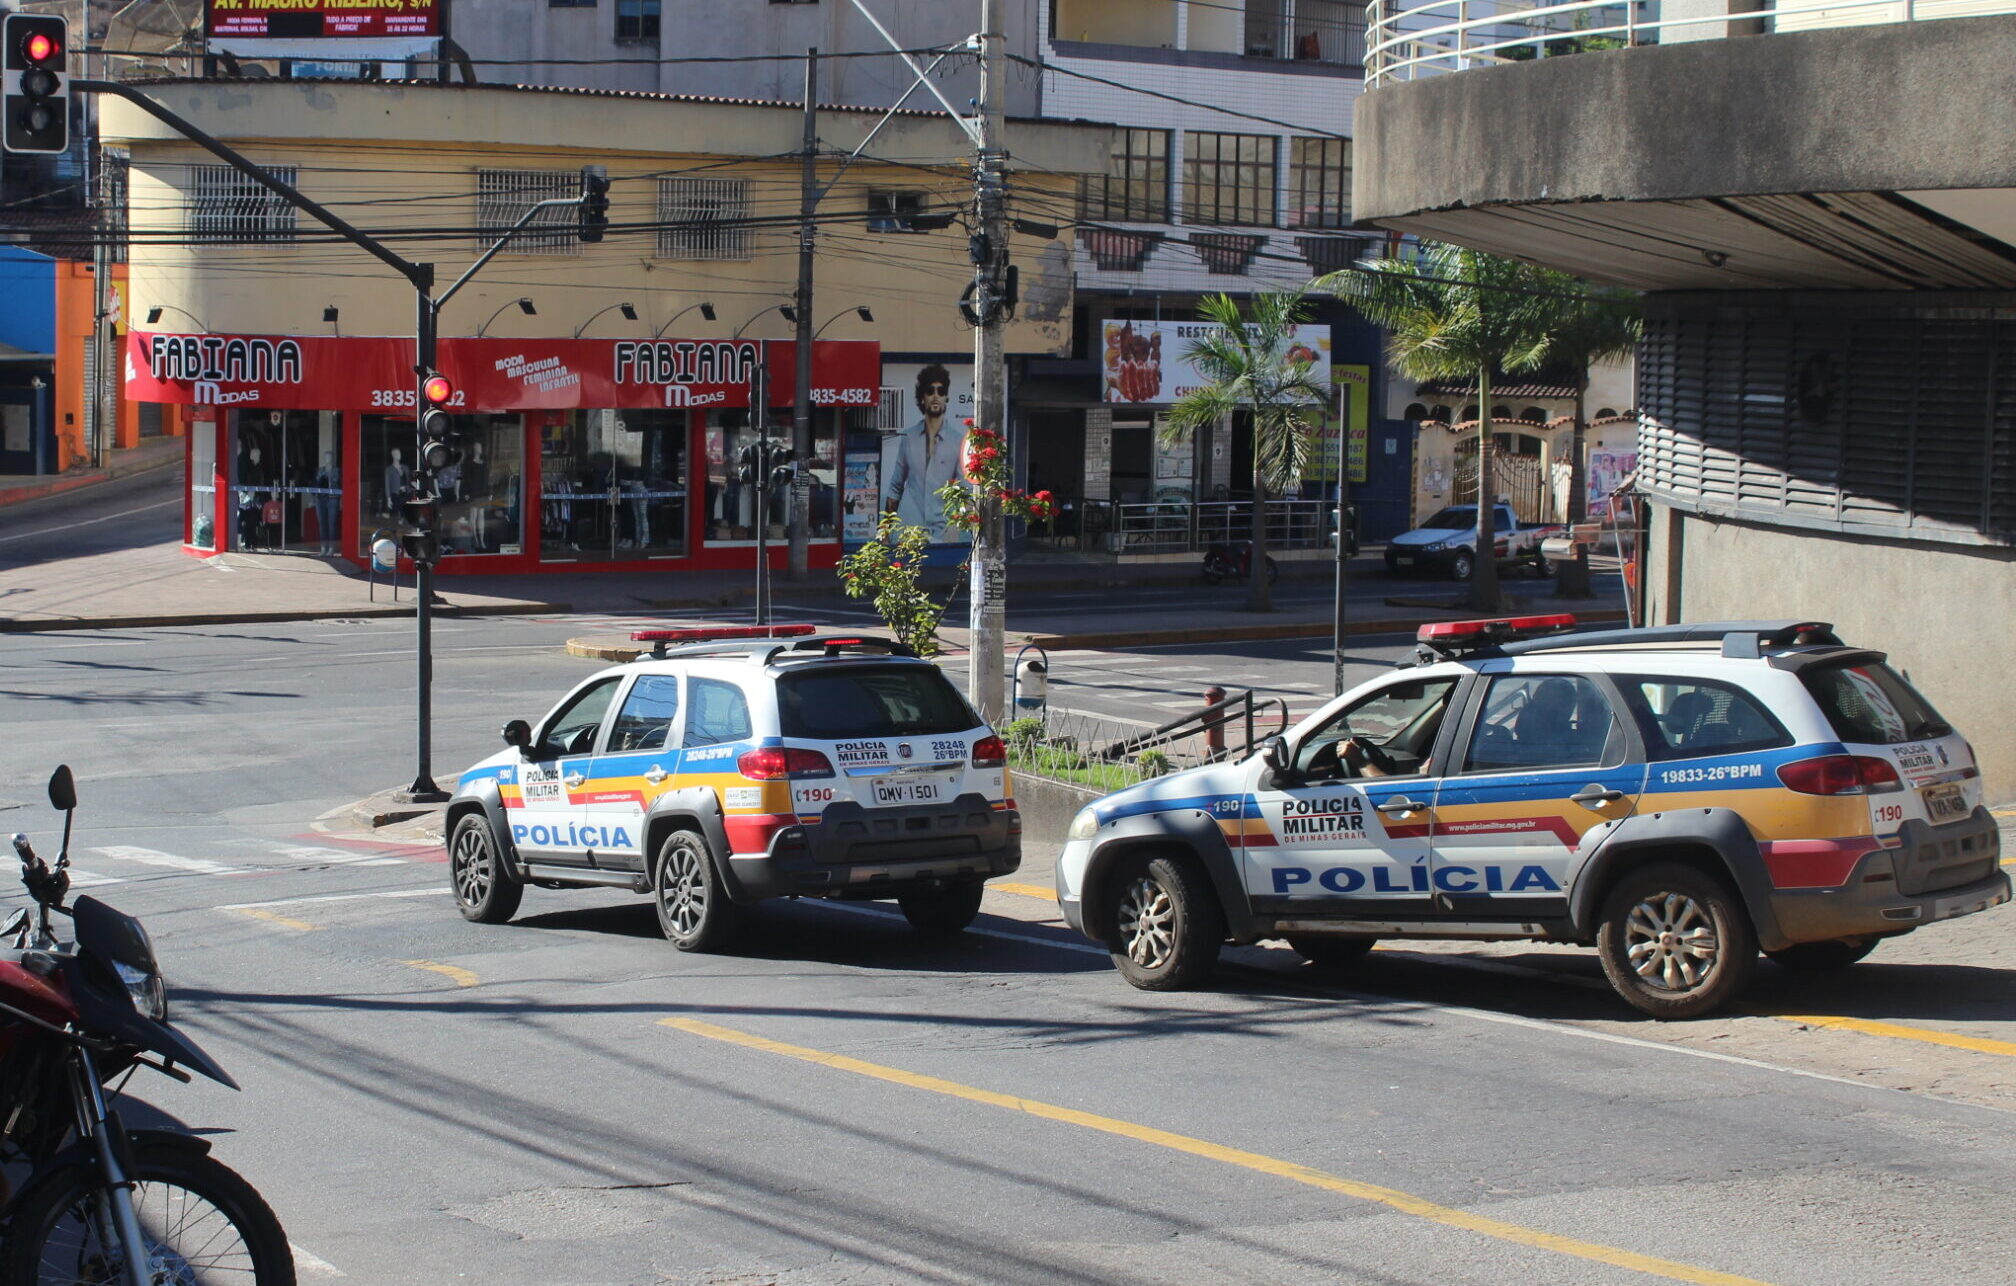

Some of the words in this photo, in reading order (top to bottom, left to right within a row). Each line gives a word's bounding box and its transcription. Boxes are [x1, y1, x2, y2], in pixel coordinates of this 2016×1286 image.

[151, 334, 302, 384] FABIANA
[495, 354, 525, 371] MODA
[507, 356, 560, 378] MASCULINA
[614, 341, 757, 384] FABIANA
[523, 366, 568, 386] FEMININA
[539, 373, 580, 393] INFANTIL
[194, 381, 260, 405] MODAS
[665, 385, 725, 407] MODAS
[932, 741, 966, 750] 28248
[838, 751, 889, 762] MILITAR
[1899, 755, 1935, 769] MILITAR
[526, 784, 559, 798] MILITAR
[802, 788, 833, 802] 190
[1213, 800, 1239, 812] 190
[1878, 805, 1902, 822] 190
[1283, 815, 1363, 834] MILITAR
[512, 821, 633, 848] POLÍCIA
[1284, 836, 1296, 844] DE
[1299, 833, 1329, 843] MINAS
[1331, 831, 1367, 841] GERAIS
[1271, 856, 1562, 893] POLÍCIA
